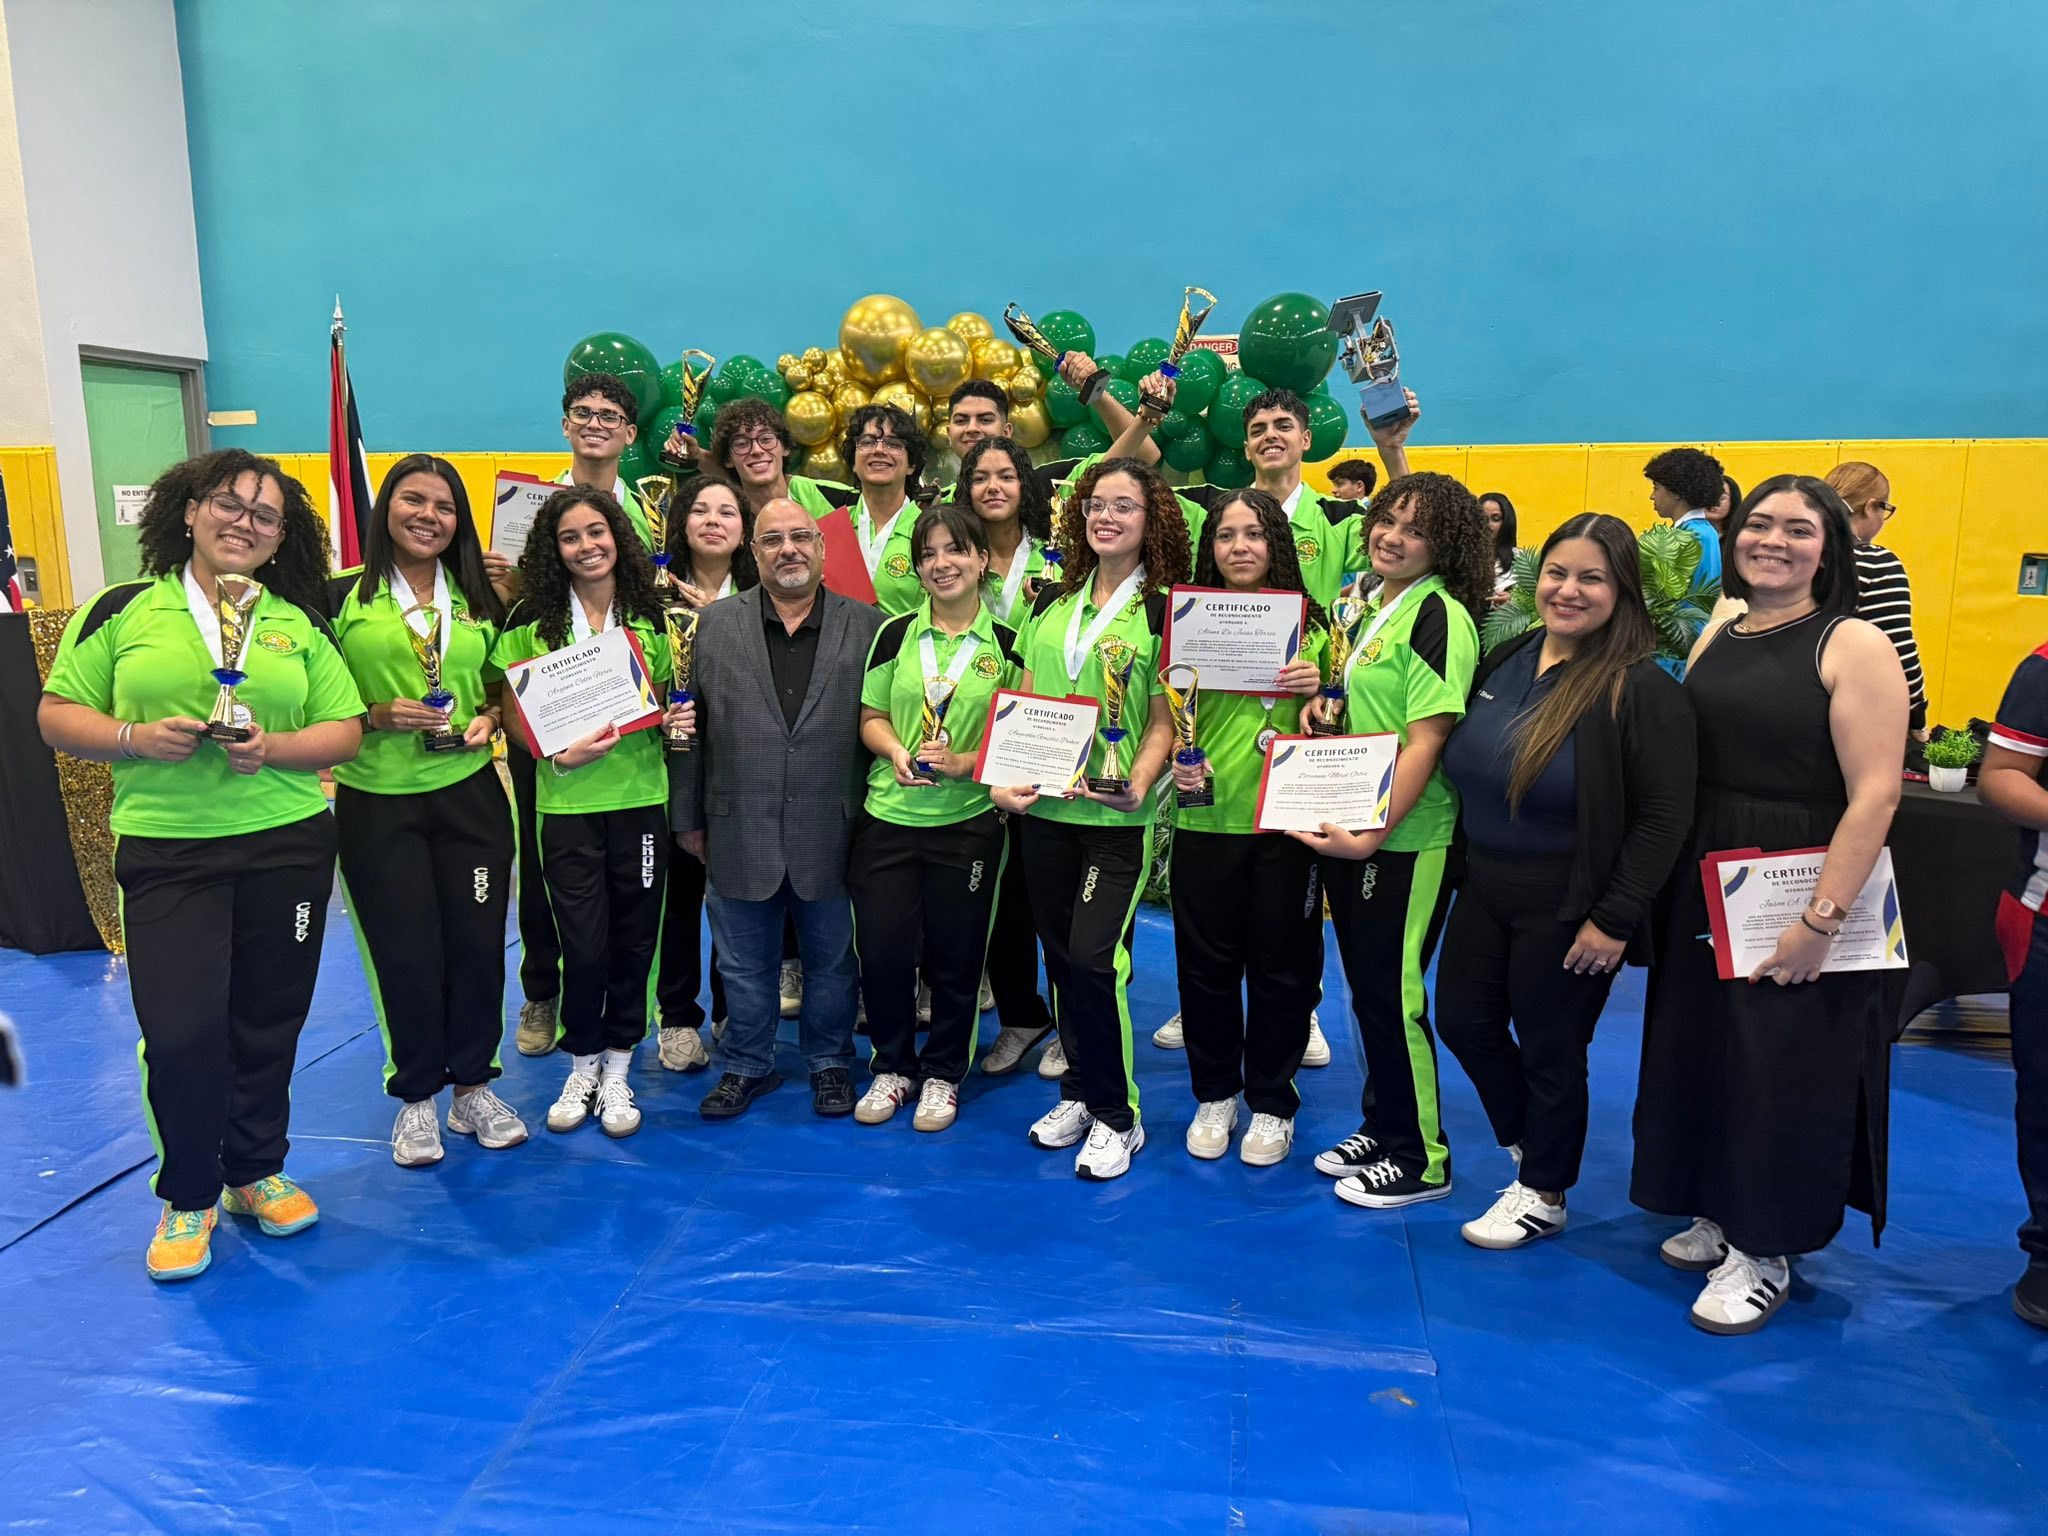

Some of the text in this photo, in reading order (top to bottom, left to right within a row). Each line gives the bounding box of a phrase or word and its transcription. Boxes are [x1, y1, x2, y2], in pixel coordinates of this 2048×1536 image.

[1190, 342, 1233, 352] DANGER
[1205, 603, 1271, 612] CERTIFICADO
[541, 646, 601, 674] CERTIFICADO
[556, 657, 597, 676] RECONOCIMIENTO
[1024, 707, 1075, 721] CERTIFICADO
[1033, 718, 1067, 727] RECONOCIMIENTO
[1304, 747, 1368, 757] CERTIFICADO
[642, 833, 654, 889] CROEV
[1763, 866, 1821, 879] CERTIFIC
[473, 867, 489, 903] CROEV
[968, 860, 985, 892] CROEV
[1082, 866, 1100, 903] CROEV
[1361, 863, 1379, 900] CROEV
[295, 901, 311, 942] CROEV
